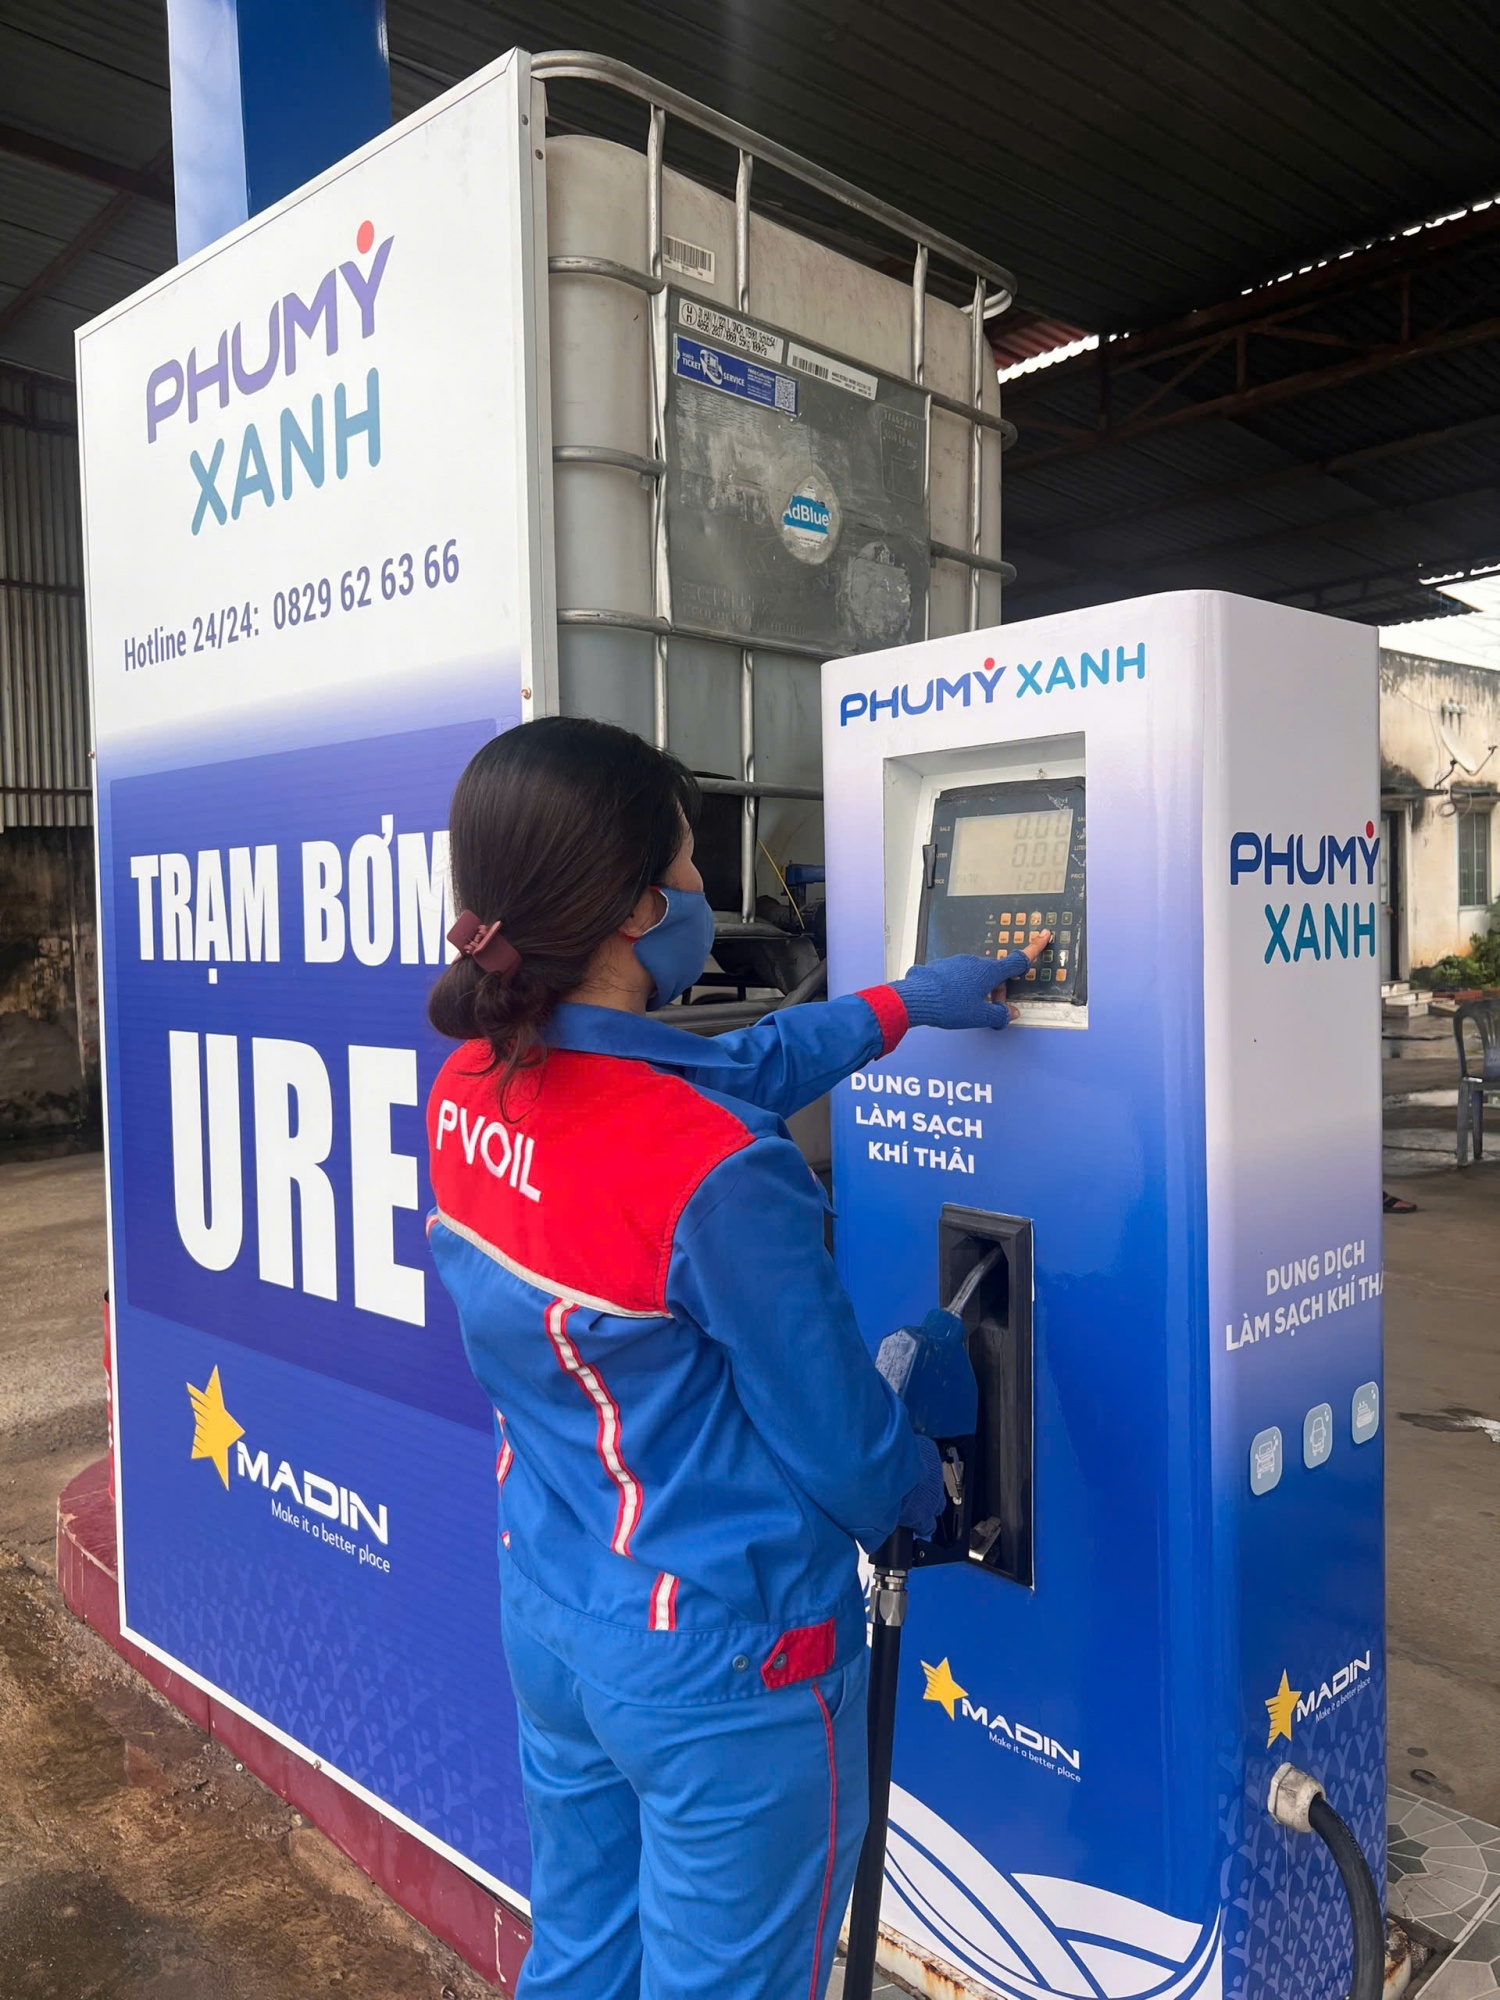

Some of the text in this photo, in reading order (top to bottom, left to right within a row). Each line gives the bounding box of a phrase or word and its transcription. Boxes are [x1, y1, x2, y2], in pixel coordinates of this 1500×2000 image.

[682, 357, 702, 371] TICKET
[723, 372, 745, 387] SERVICE
[189, 367, 382, 536] XANH
[124, 538, 460, 671] Hotline 24/24: 0829 62 63 66
[1015, 642, 1146, 699] XANH
[130, 814, 452, 984] TRẠM BƠM
[1264, 902, 1376, 965] XANH
[850, 1072, 993, 1106] DUNG DỊCH
[855, 1103, 983, 1140] LÀM SẠCH
[168, 1029, 426, 1327] URE
[436, 1099, 541, 1203] PVOIL
[868, 1140, 975, 1174] KHÍ THẢI
[1266, 1239, 1365, 1296] DUNG DỊCH
[1226, 1312, 1271, 1351] LÀM
[1274, 1293, 1323, 1336] SẠCH
[1327, 1274, 1356, 1316] KHÍ
[236, 1440, 389, 1546] MADIN
[271, 1498, 391, 1574] Make it a better place
[1296, 1649, 1371, 1723] MADIN
[1315, 1706, 1331, 1724] Make
[1331, 1702, 1336, 1711] it
[1340, 1688, 1357, 1704] better
[1356, 1676, 1371, 1694] place
[961, 1697, 1080, 1770] MADIN
[988, 1731, 1081, 1783] Make it a better place
